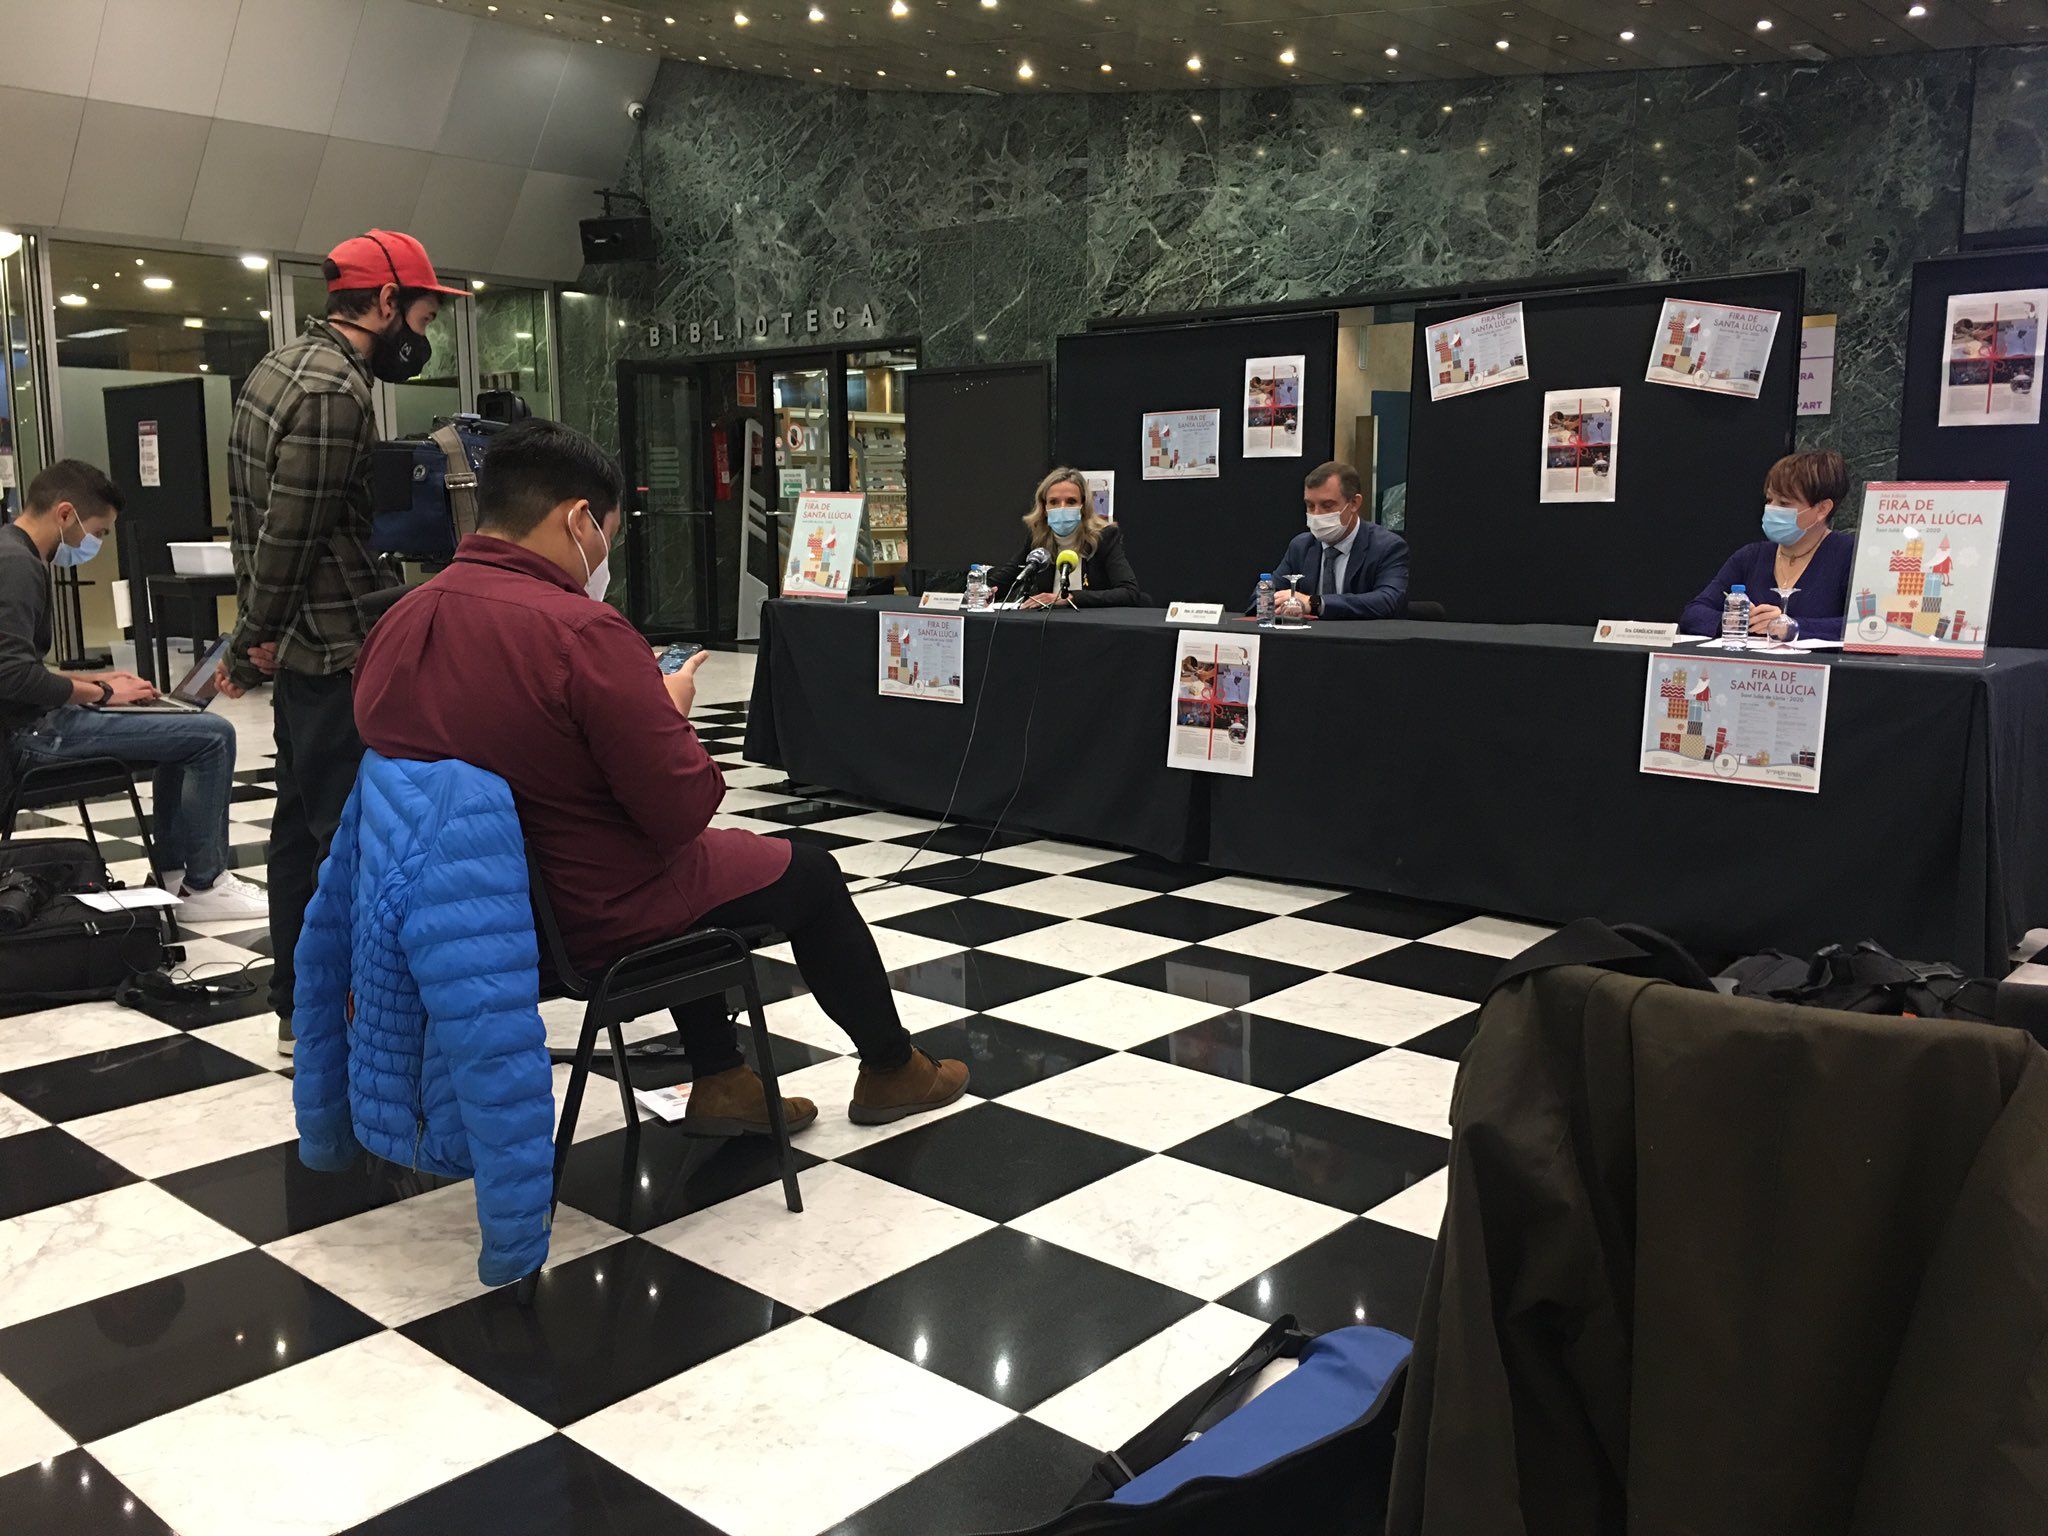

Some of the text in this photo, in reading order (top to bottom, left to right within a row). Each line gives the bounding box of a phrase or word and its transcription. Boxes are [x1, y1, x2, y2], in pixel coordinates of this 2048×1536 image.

[1481, 315, 1495, 323] FIRA
[1729, 312, 1758, 322] FIRA DE
[650, 304, 874, 347] BIBLIOTECA
[1471, 323, 1493, 334] SANTA
[1713, 319, 1740, 329] SANTA
[1878, 499, 1935, 510] FIRA DE
[802, 511, 826, 519] SANTA
[1876, 510, 1983, 525] SANTA LLÚCIA
[941, 621, 950, 629] DE
[918, 628, 938, 637] SANTA
[1751, 669, 1797, 682] FIRA DE
[1730, 680, 1771, 693] SANTA
